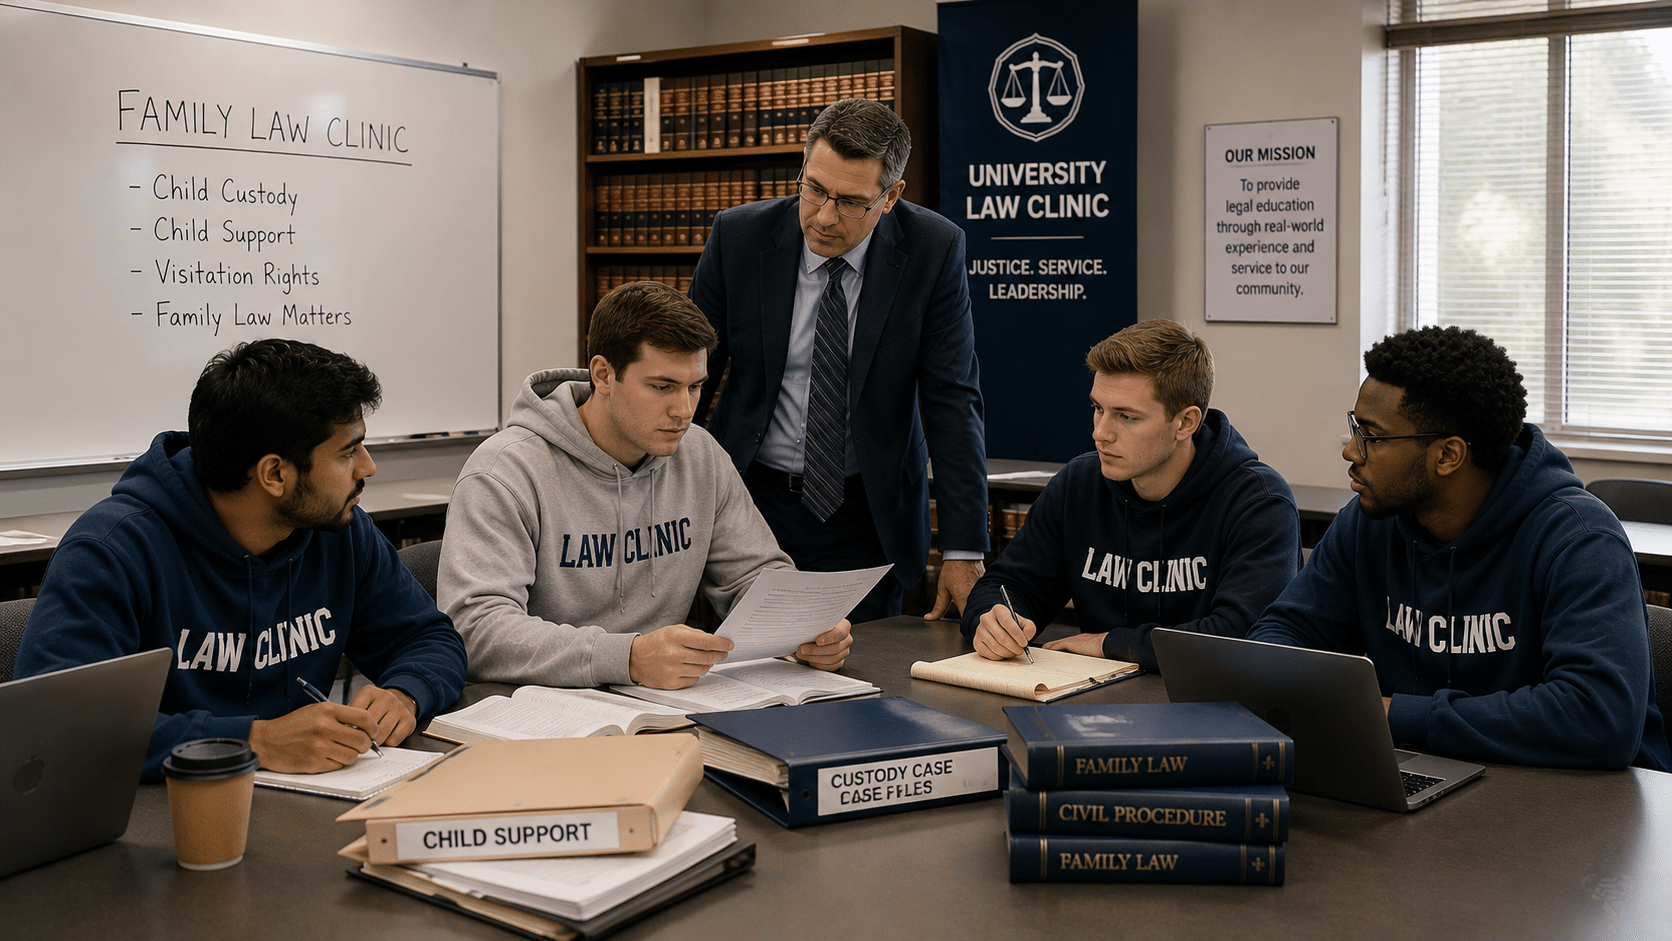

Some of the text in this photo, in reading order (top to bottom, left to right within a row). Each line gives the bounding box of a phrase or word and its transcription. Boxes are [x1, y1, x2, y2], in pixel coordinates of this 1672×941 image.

[118, 89, 408, 153] FAMILY LAW CLINIC
[1225, 145, 1315, 163] OUR MISSION
[968, 160, 1107, 187] UNIVERSITY
[1240, 177, 1300, 194] To provide
[153, 173, 298, 216] Child Custody
[966, 193, 1109, 220] LAW CLINIC
[1226, 198, 1314, 216] legal education
[154, 216, 296, 252] Child Support
[1216, 218, 1324, 236] through real-world
[1225, 239, 1315, 257] experience and
[155, 259, 320, 295] Visitation Rights
[968, 258, 1107, 275] JUSTICE. SERVICE.
[1231, 261, 1310, 274] service to our
[989, 283, 1087, 300] LEADERSHIP.
[1236, 281, 1304, 298] community.
[157, 301, 352, 336] Family Law Matters
[559, 517, 692, 568] LAW CLINIC
[1081, 546, 1207, 593] LAW CLINIC
[1385, 595, 1516, 654] LAW CLINIC
[177, 606, 336, 672] LAW CLINIC
[831, 759, 953, 789] CUSTODY CASE
[1075, 756, 1188, 775] FAMILY LAW
[840, 787, 883, 806] CASE
[1058, 804, 1227, 827] CIVIL PROCEDURE
[423, 823, 592, 850] CHILD SUPPORT
[1059, 853, 1179, 871] FAMILY LAW
